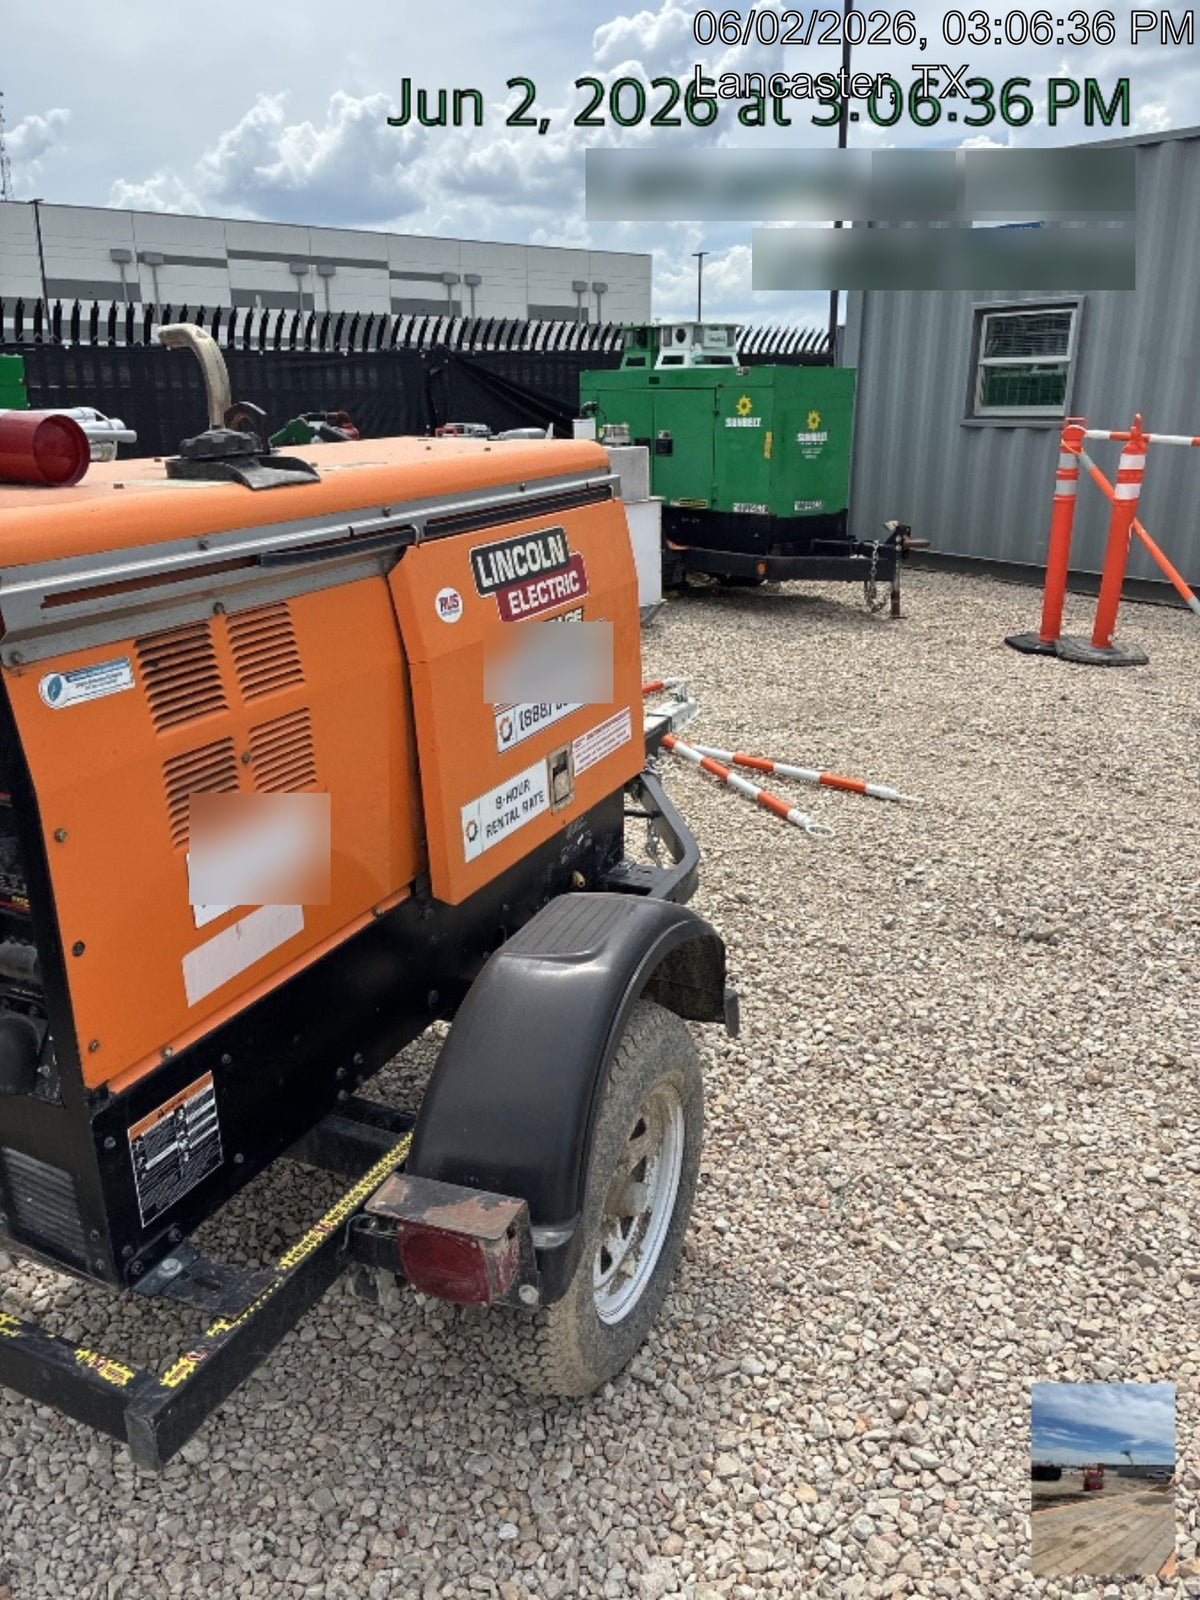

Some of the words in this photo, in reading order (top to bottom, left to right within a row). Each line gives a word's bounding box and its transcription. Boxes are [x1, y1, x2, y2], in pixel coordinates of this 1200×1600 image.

[725, 417, 762, 428] SUNBELT
[476, 534, 566, 588] LINCOLN
[508, 570, 580, 615] ELECTRIC
[486, 806, 520, 838] RENTAL
[522, 790, 545, 813] RATE
[495, 778, 531, 810] 8-HOUR
